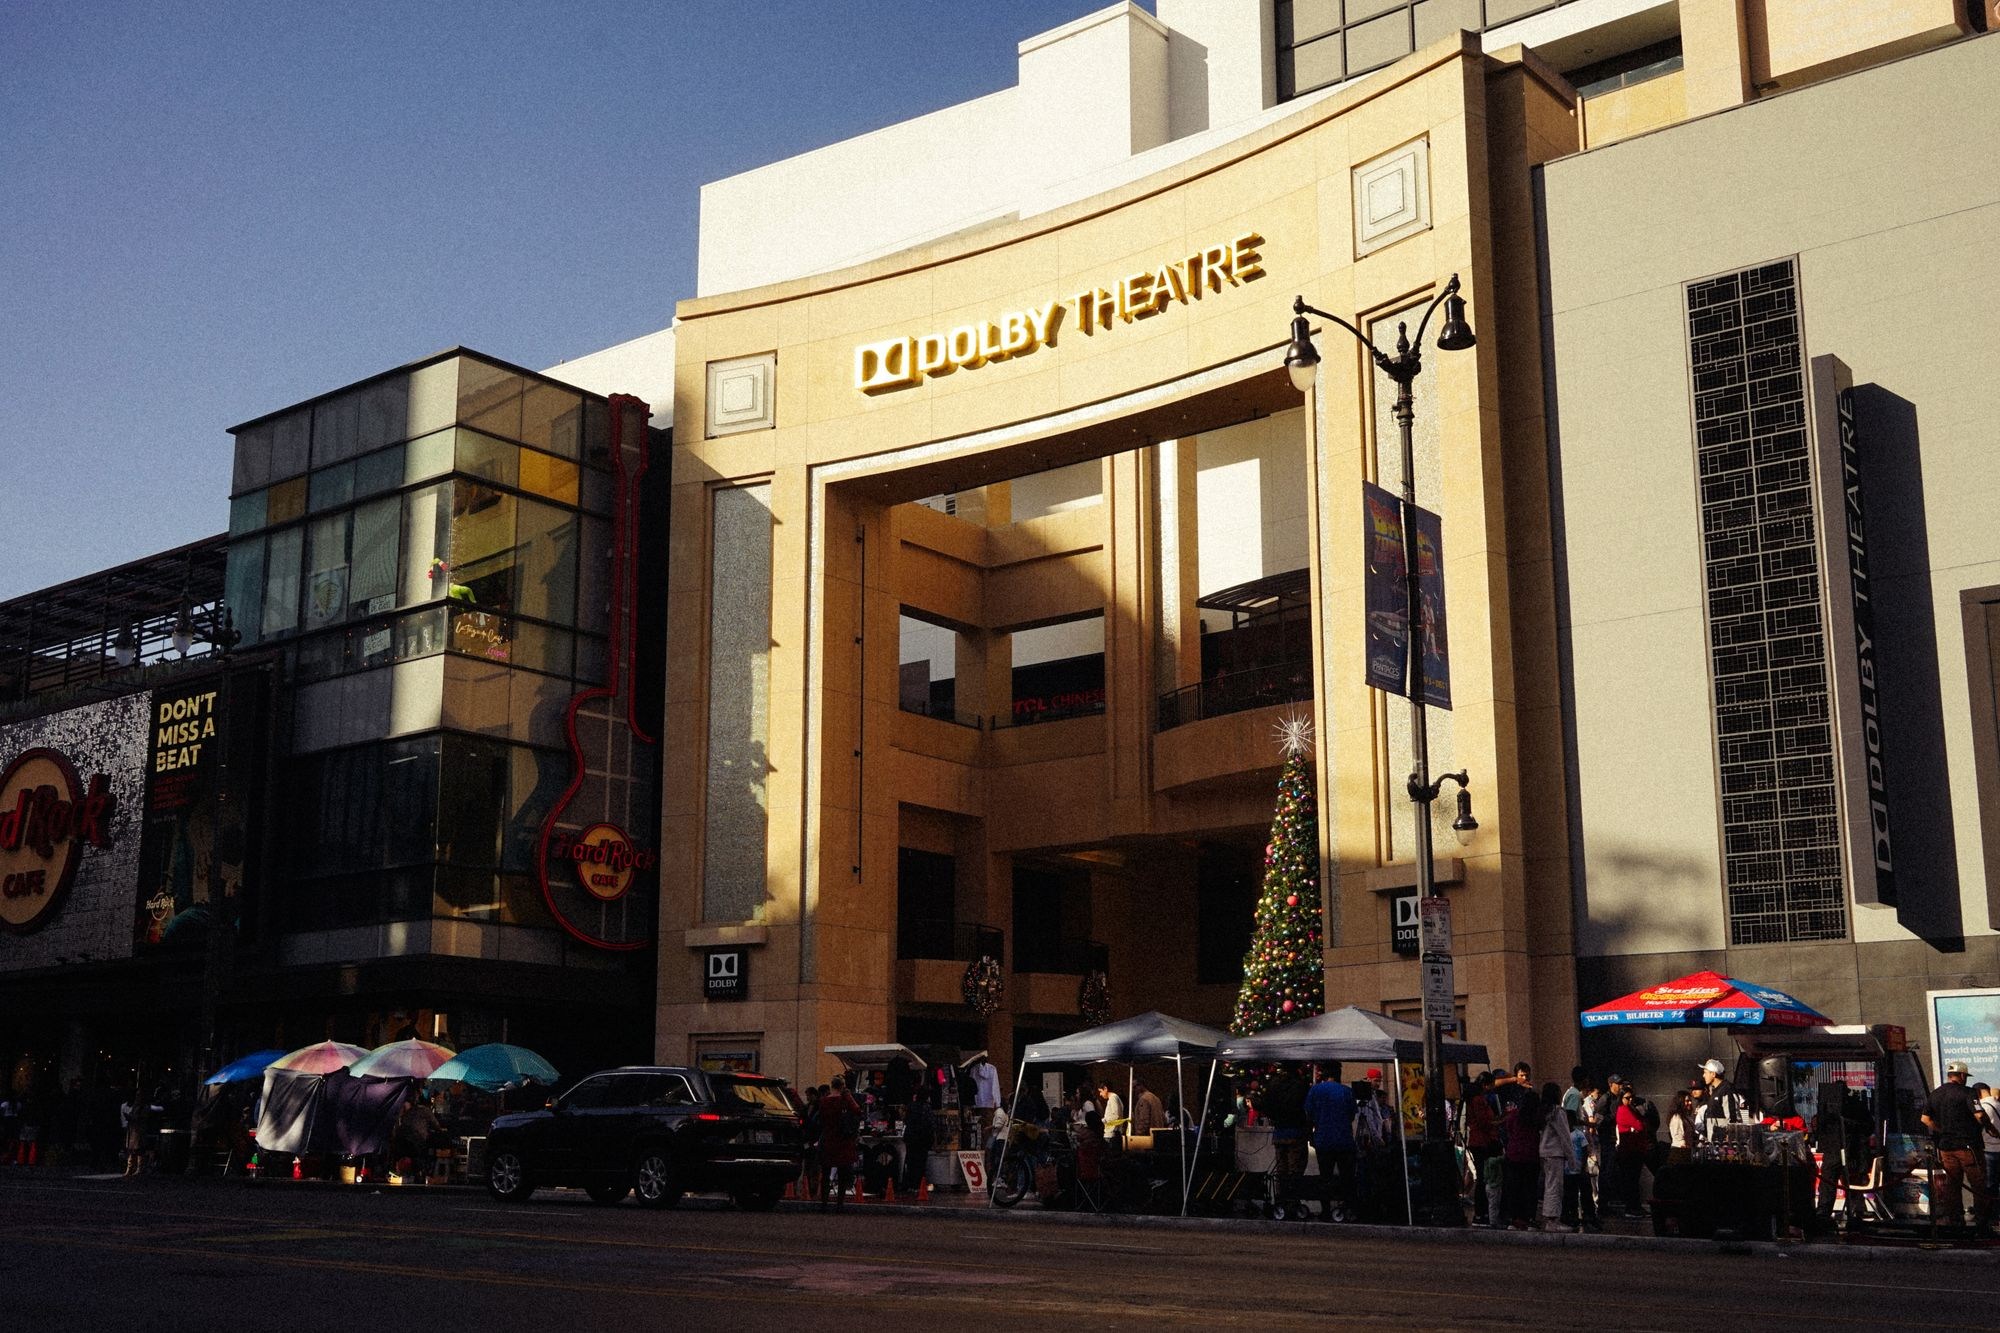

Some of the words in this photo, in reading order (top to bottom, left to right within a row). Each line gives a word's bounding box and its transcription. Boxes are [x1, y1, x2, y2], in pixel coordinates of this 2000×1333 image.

[918, 301, 1062, 375] DOLBY
[1066, 232, 1262, 335] THEATRE
[1841, 390, 1868, 608] THEATRE
[159, 692, 217, 724] DON'T
[1013, 697, 1048, 715] TCL
[1858, 624, 1884, 792] DOLBY
[157, 721, 199, 748] MISS
[201, 717, 216, 739] A
[156, 744, 202, 773] BEAT
[551, 833, 610, 864] Hard
[610, 840, 657, 873] Rock
[3, 870, 46, 899] CAFE
[592, 874, 619, 888] CAFE
[1397, 929, 1420, 940] DOL
[708, 979, 738, 988] DOLBY
[1586, 1013, 1619, 1022] TICKETS
[1626, 1011, 1664, 1020] BILHETES
[1703, 1011, 1736, 1019] BILLETS
[1943, 1036, 1972, 1044] Where
[1983, 1035, 1998, 1043] the
[1944, 1046, 1969, 1054] world
[1970, 1045, 1997, 1053] would
[1973, 1055, 1999, 1063] time?
